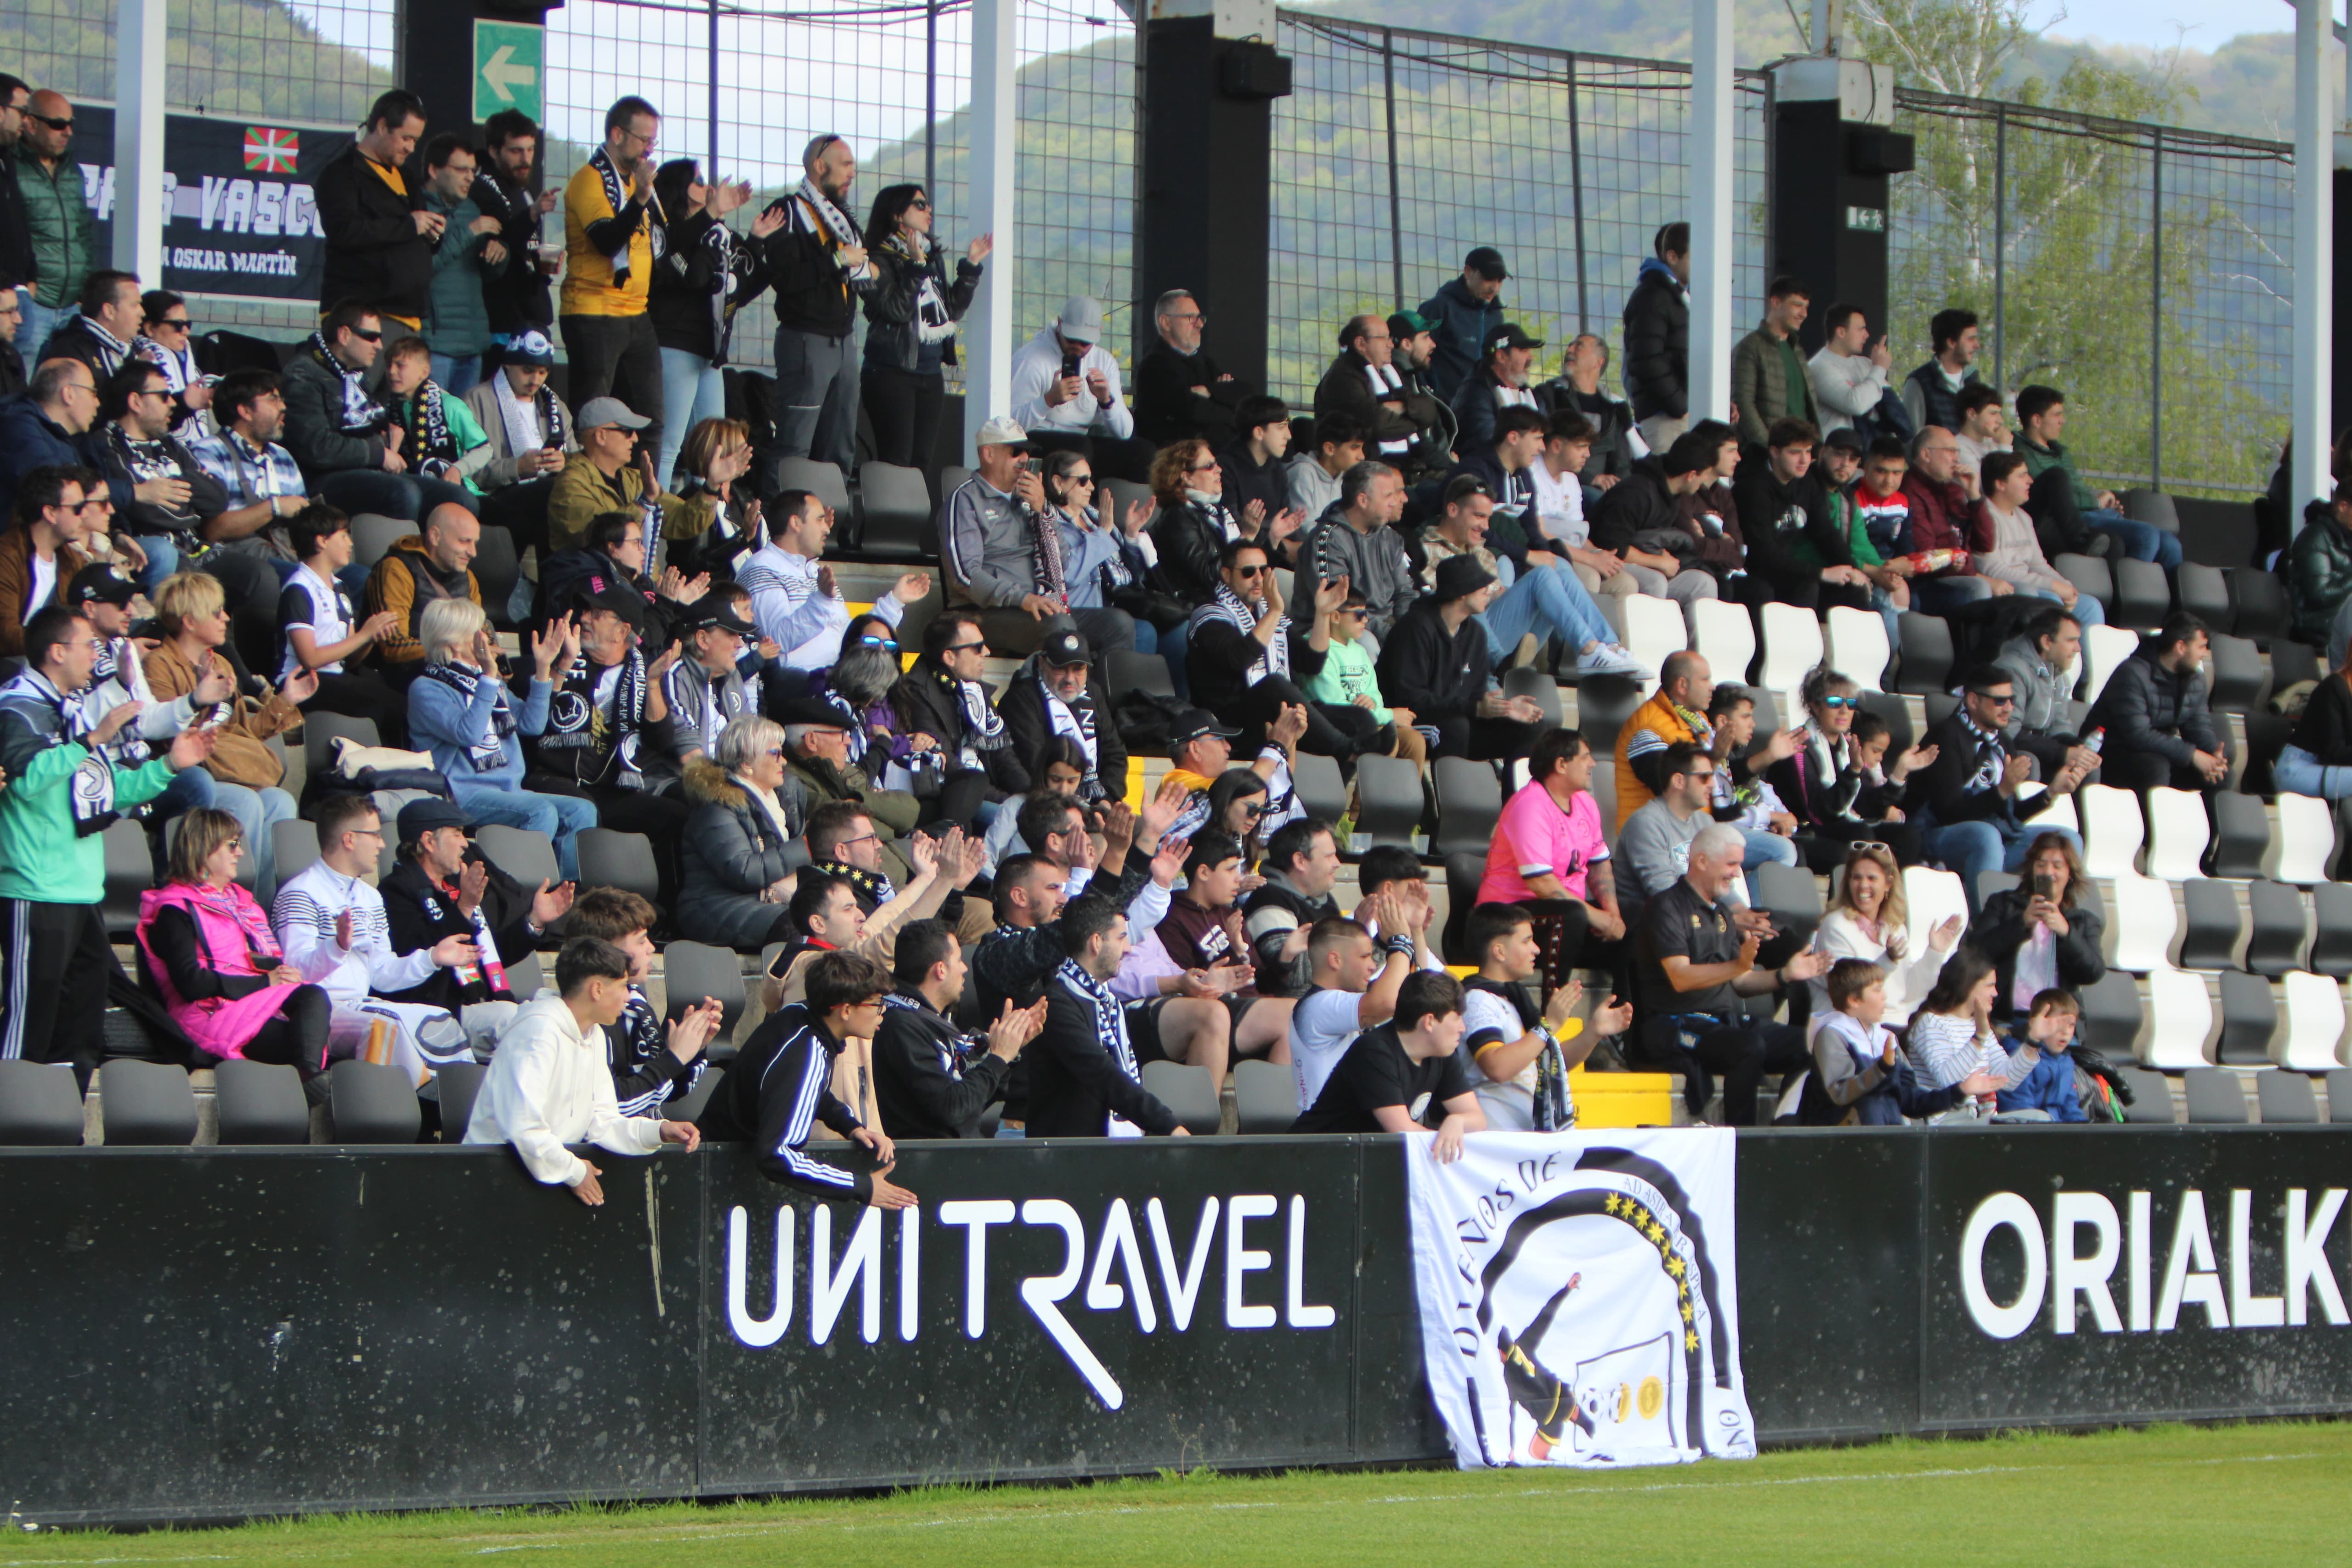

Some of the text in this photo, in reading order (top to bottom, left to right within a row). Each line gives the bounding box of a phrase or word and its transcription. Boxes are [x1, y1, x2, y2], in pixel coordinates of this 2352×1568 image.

[77, 163, 178, 226] PAS
[173, 248, 228, 272] OSKAR
[232, 249, 297, 276] MARTÍN
[1516, 1150, 1562, 1194] DE
[1623, 1177, 1642, 1195] AD
[1645, 1187, 1673, 1227] ASTRA
[1959, 1187, 2352, 1340] ORIALK
[728, 1194, 1335, 1411] UNITRAVEL
